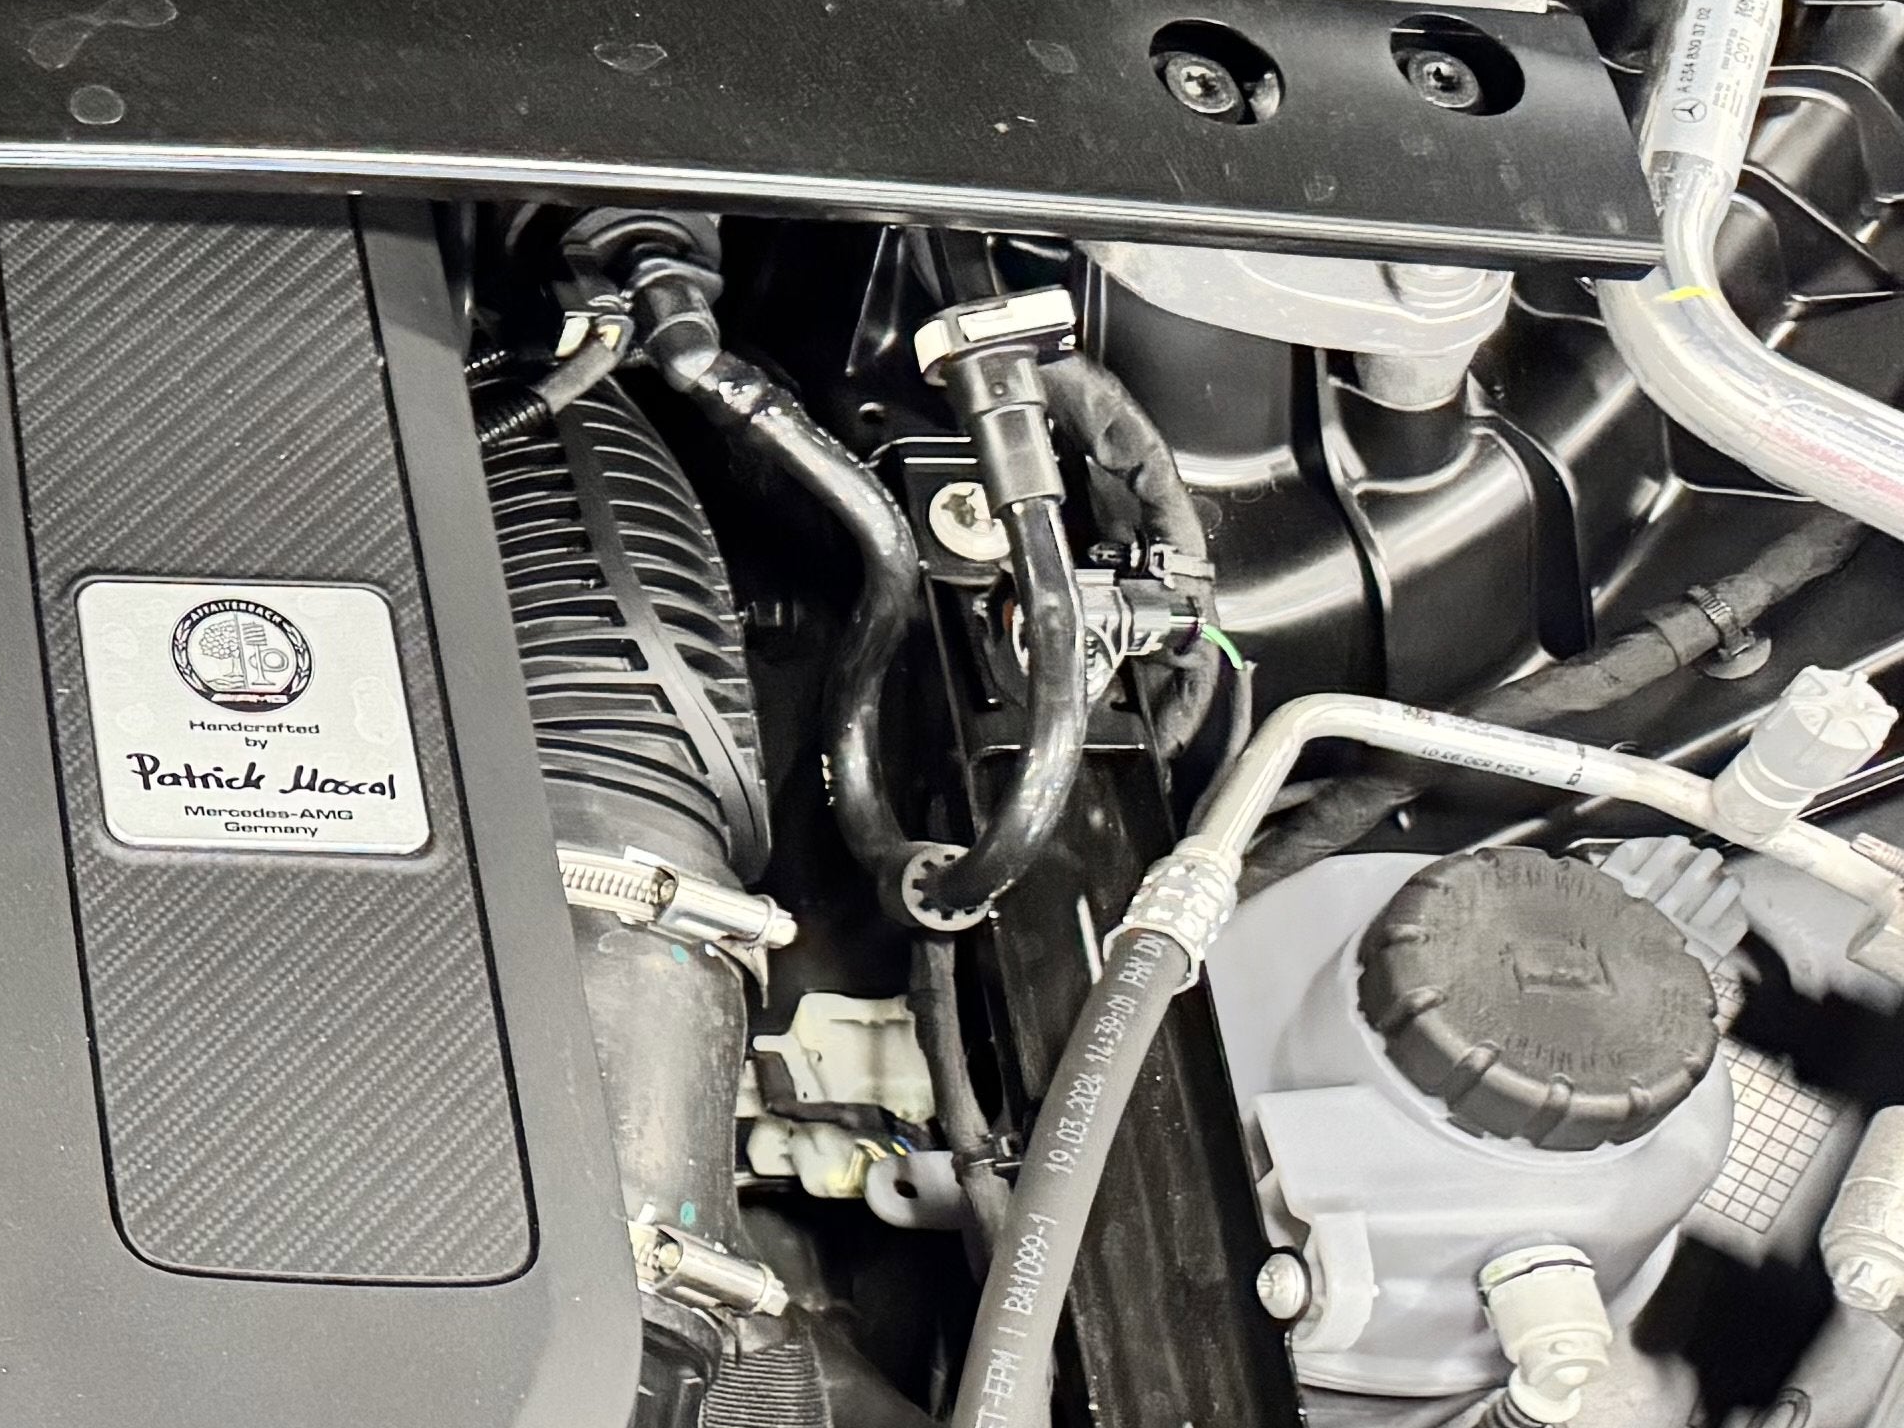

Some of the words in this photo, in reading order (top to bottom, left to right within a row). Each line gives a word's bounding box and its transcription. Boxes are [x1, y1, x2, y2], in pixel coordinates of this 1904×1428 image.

[188, 719, 320, 734] Handcrafted
[244, 736, 268, 750] by
[126, 752, 266, 791] Patrick
[184, 805, 354, 820] Mercedes-AMG
[224, 821, 319, 838] Germany
[1001, 1212, 1057, 1316] BA1099-1
[1044, 1072, 1106, 1174] 19.03.2024
[1085, 994, 1139, 1066] 14:39:01
